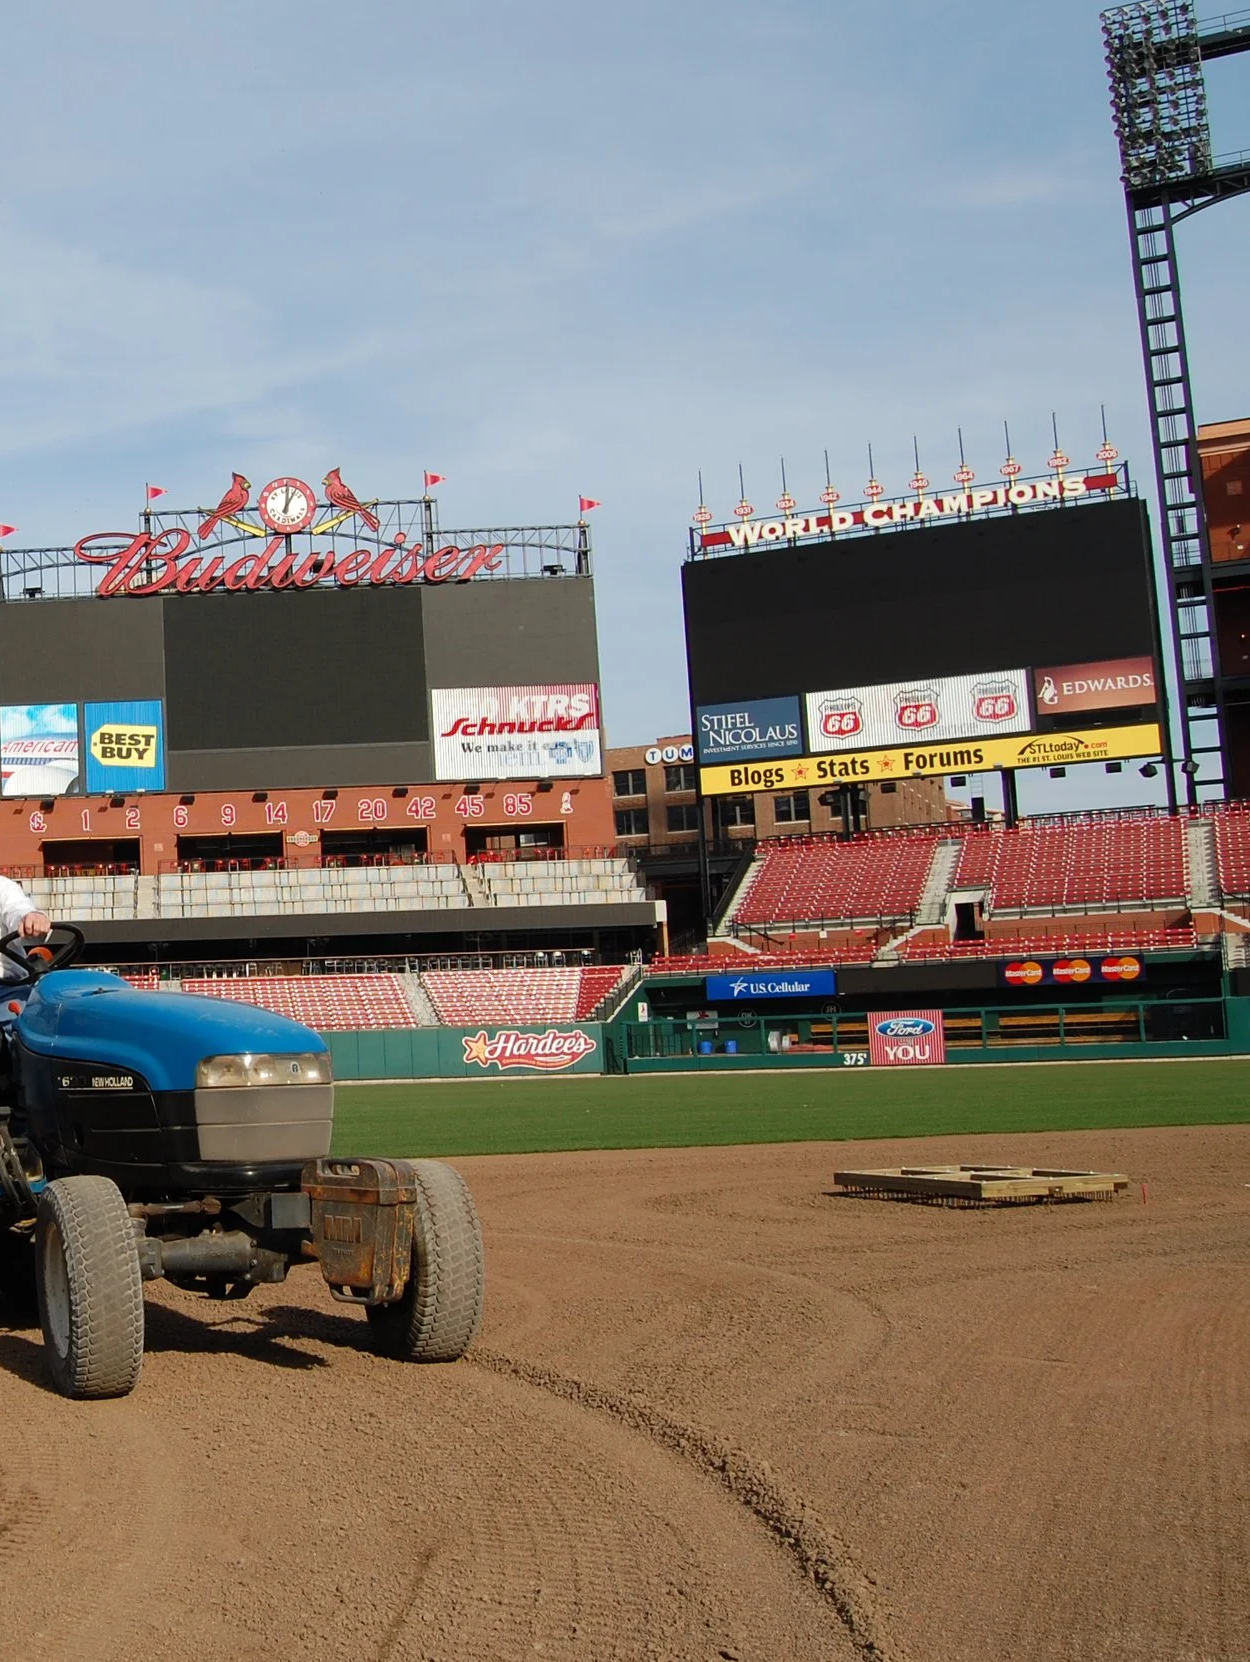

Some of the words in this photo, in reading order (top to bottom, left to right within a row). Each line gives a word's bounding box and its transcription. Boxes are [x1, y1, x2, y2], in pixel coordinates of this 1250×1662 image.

[728, 512, 854, 547] WORLD
[863, 476, 1087, 526] CHAMPIONS
[736, 507, 751, 515] 1931
[777, 500, 794, 508] 1934
[73, 528, 505, 596] Budweiser
[1062, 673, 1151, 696] EDWARDS
[511, 692, 590, 718] KTRS
[901, 706, 932, 725] 66
[979, 698, 1010, 716] 66
[441, 713, 594, 737] Schnucks
[701, 712, 754, 732] STIFEL
[826, 715, 856, 732] 66
[99, 732, 155, 747] BEST
[709, 723, 798, 747] NICOLAUS
[101, 747, 149, 761] BUY
[461, 742, 483, 753] We
[487, 740, 523, 752] make
[1053, 753, 1074, 761] LOUIS
[729, 766, 784, 788] Blogs
[817, 756, 869, 779] Stats
[903, 748, 994, 770] Forums
[221, 804, 235, 826] 9
[265, 801, 288, 824] 14
[312, 799, 336, 823] 17
[358, 798, 387, 822] 20
[406, 796, 436, 819] 42
[455, 794, 484, 818] 45
[503, 793, 533, 817] 85
[81, 809, 92, 831] 1
[126, 808, 141, 830] 2
[173, 805, 188, 828] 6
[768, 981, 810, 993] Cellular
[886, 1020, 924, 1036] Ford
[485, 1032, 593, 1059] Hardee's
[884, 1044, 930, 1061] YOU
[105, 1076, 134, 1088] HOLLAND
